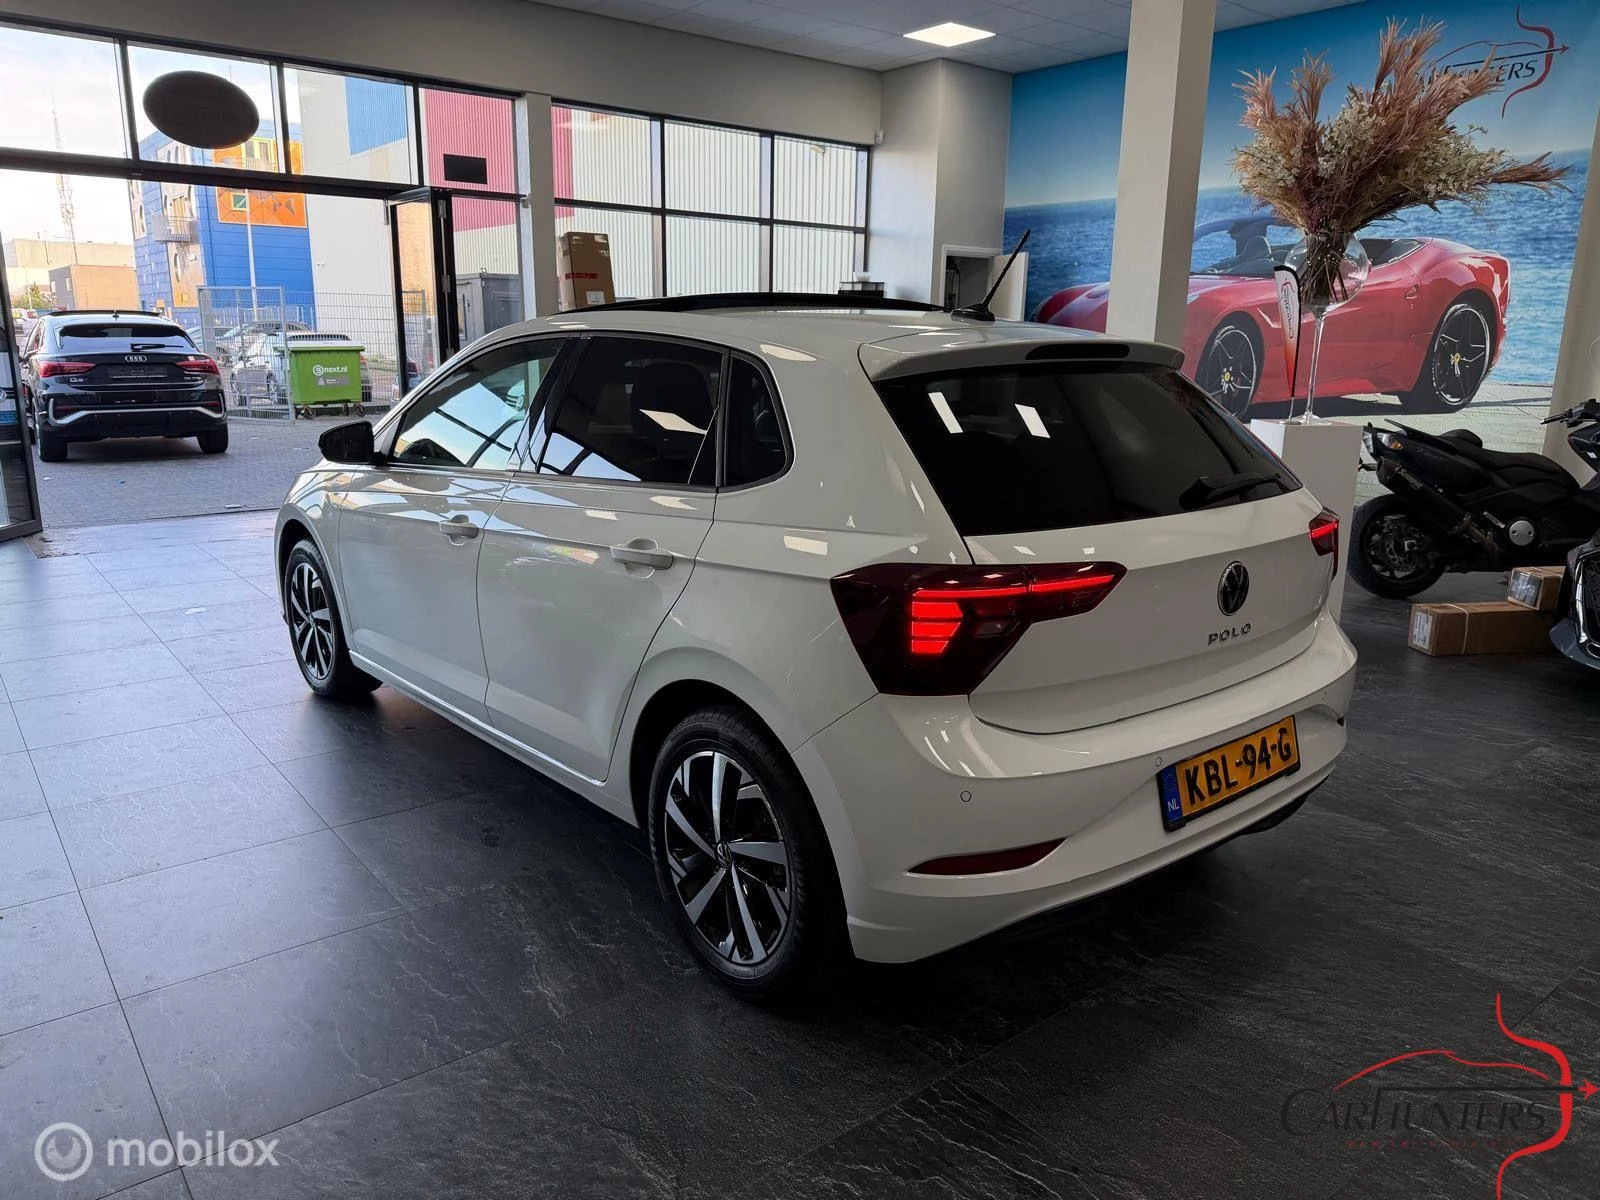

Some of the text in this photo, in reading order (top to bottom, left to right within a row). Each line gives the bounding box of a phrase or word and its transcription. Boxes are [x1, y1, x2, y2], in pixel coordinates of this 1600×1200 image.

[1208, 623, 1251, 646] POLO
[1185, 727, 1292, 805] KBL-94-G
[1167, 798, 1180, 812] NL
